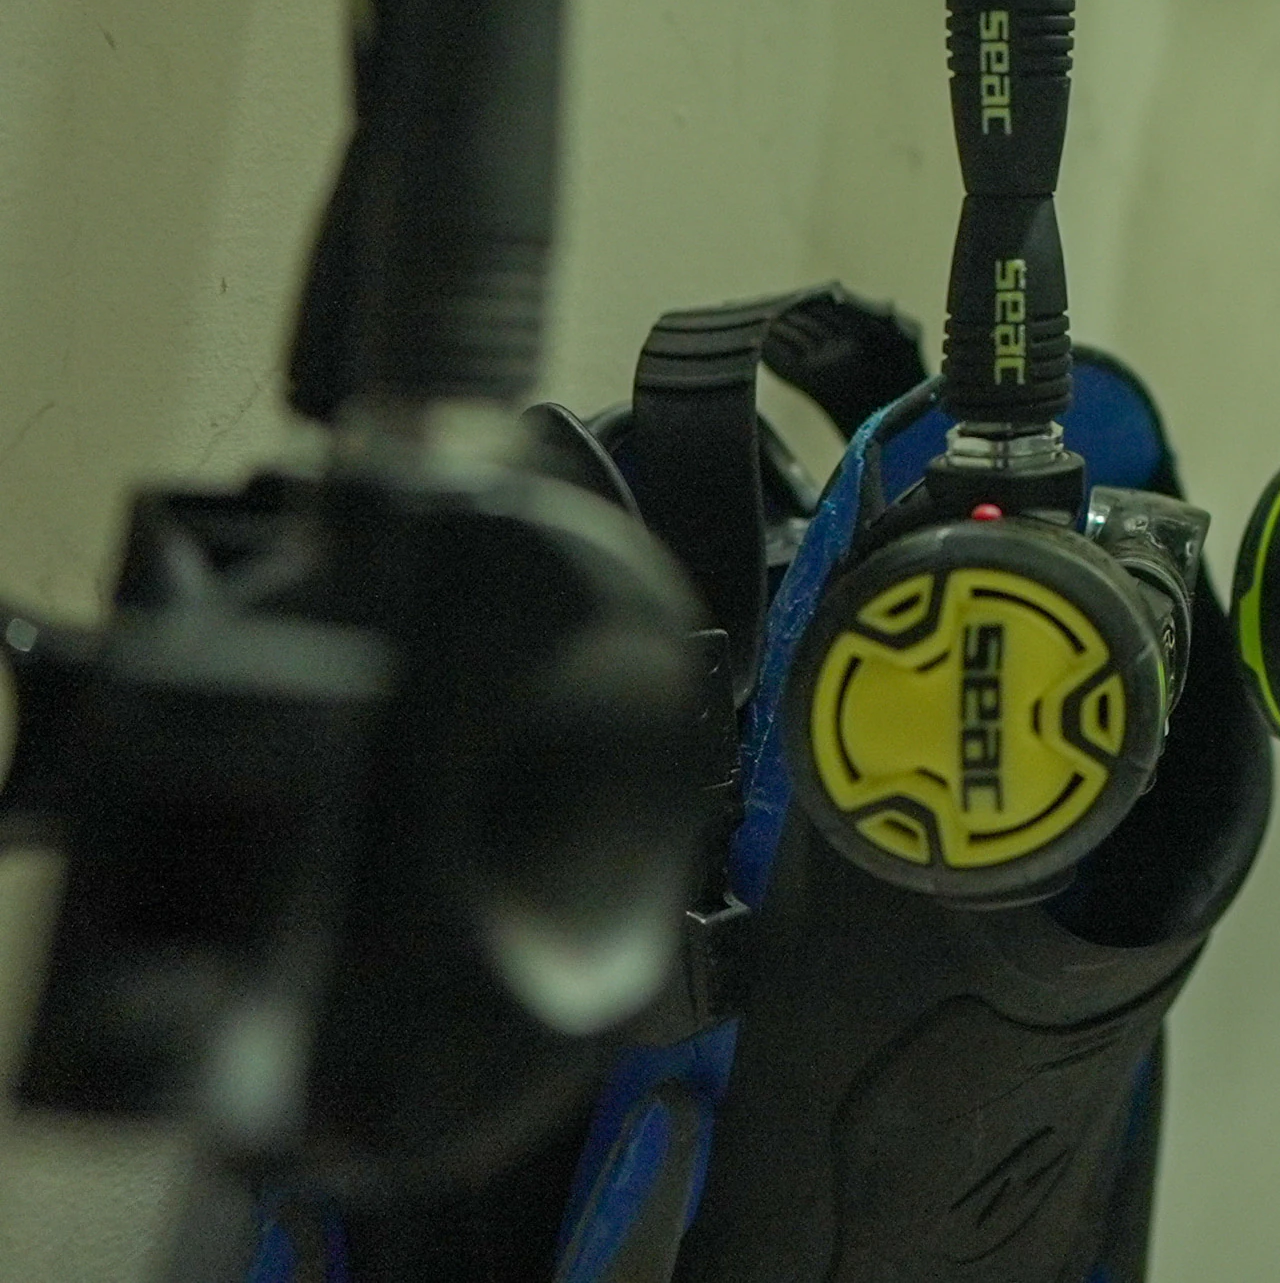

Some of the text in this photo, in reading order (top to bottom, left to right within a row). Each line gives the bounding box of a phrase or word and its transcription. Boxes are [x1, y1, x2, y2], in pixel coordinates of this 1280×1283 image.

[980, 10, 1012, 135] seac
[994, 259, 1026, 385] seac
[962, 624, 1003, 812] seac
